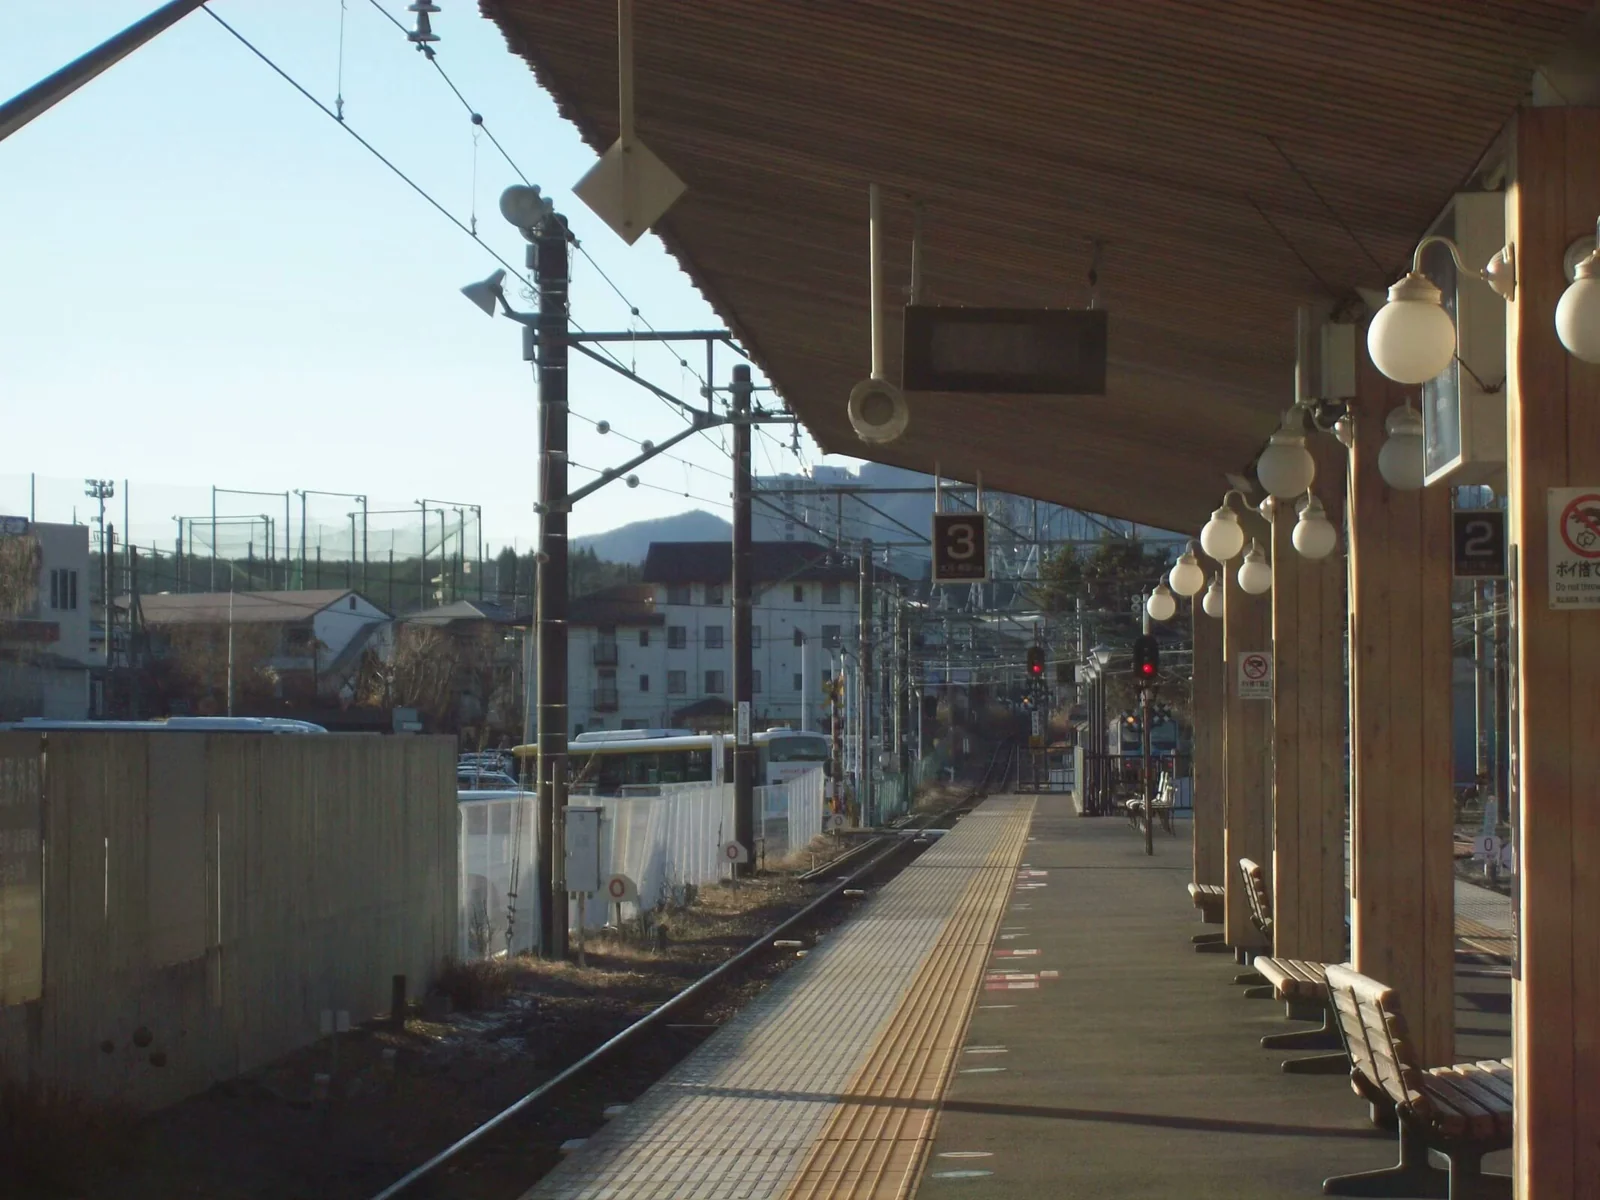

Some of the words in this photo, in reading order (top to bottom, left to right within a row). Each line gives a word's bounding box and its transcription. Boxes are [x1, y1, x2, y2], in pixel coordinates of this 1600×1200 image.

[947, 523, 975, 559] 3
[1465, 520, 1494, 556] 2
[1555, 582, 1566, 591] Do
[1568, 583, 1579, 591] not
